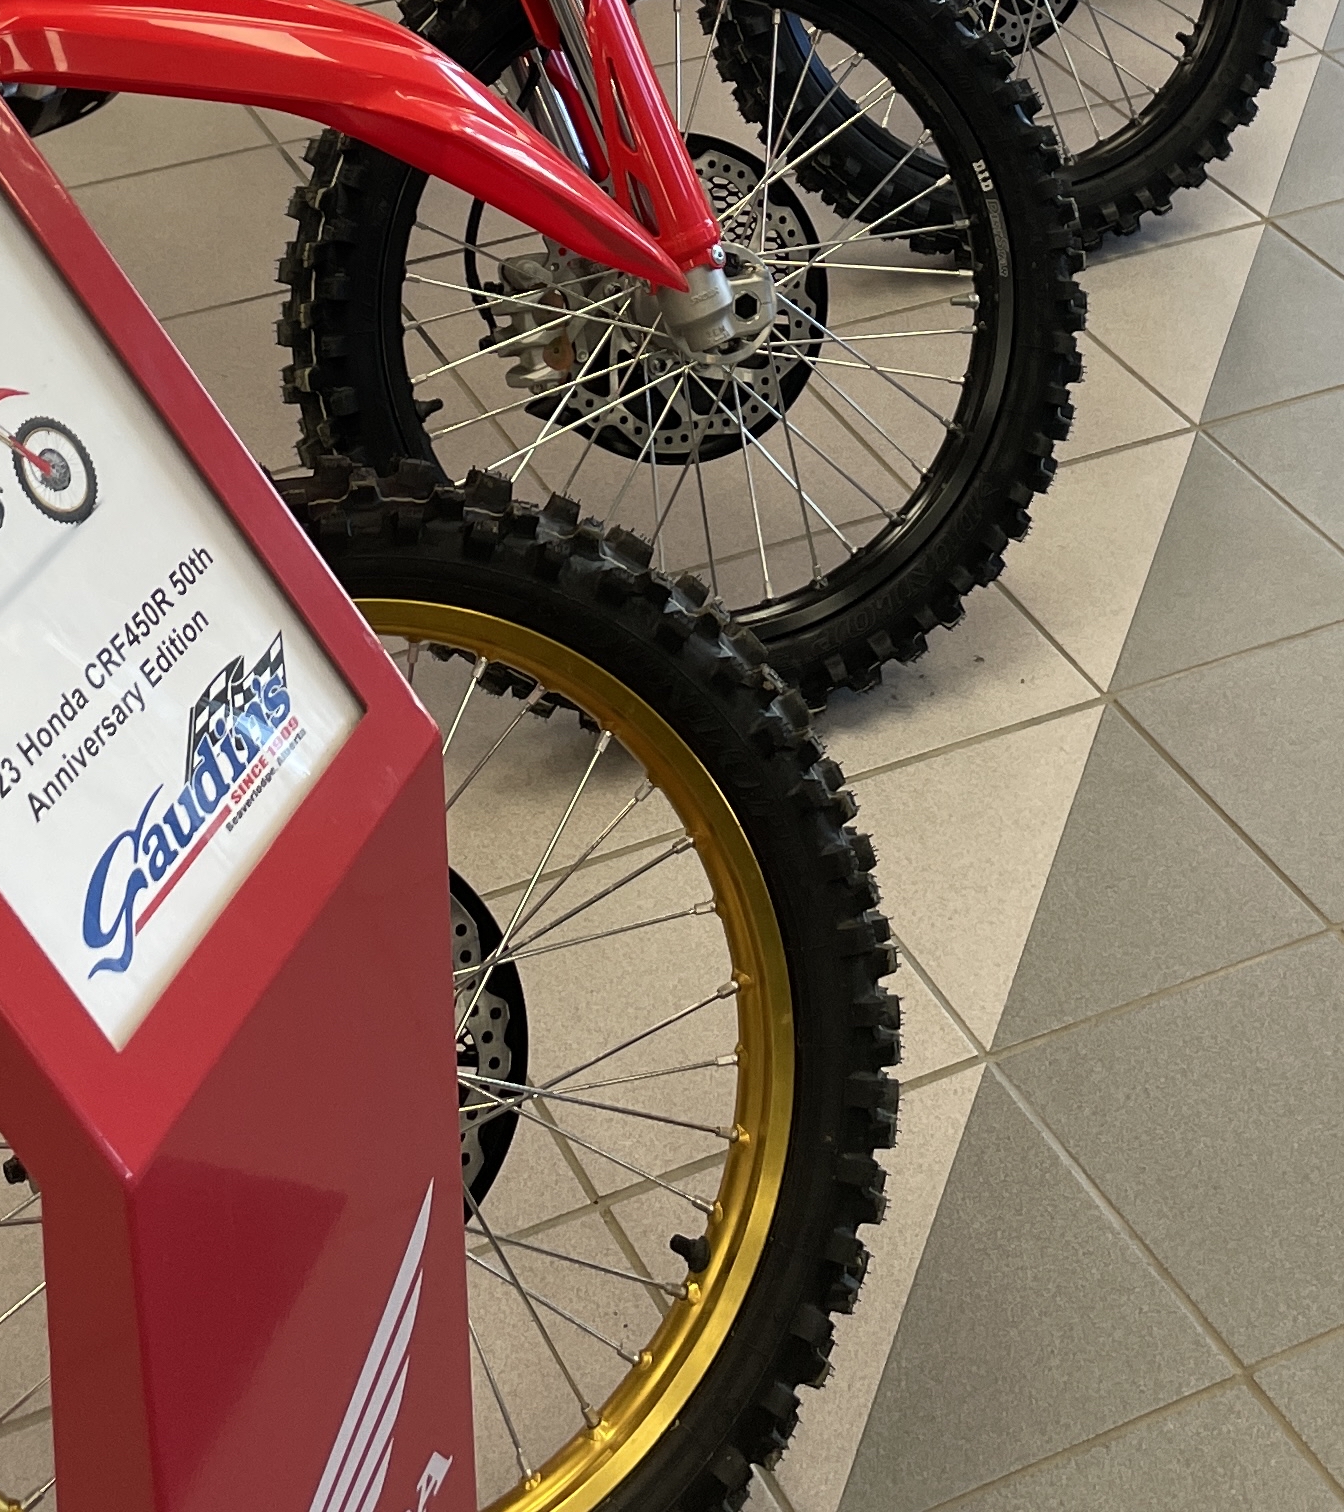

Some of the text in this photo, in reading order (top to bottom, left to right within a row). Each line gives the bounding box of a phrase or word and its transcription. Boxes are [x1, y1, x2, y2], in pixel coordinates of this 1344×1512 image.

[15, 687, 90, 766] Honda
[84, 587, 175, 690] CRF450R
[168, 547, 215, 596] 50th
[27, 609, 210, 823] Anniversary Edition
[230, 715, 300, 806] SINCE 1909
[82, 671, 291, 980] Gaudin's
